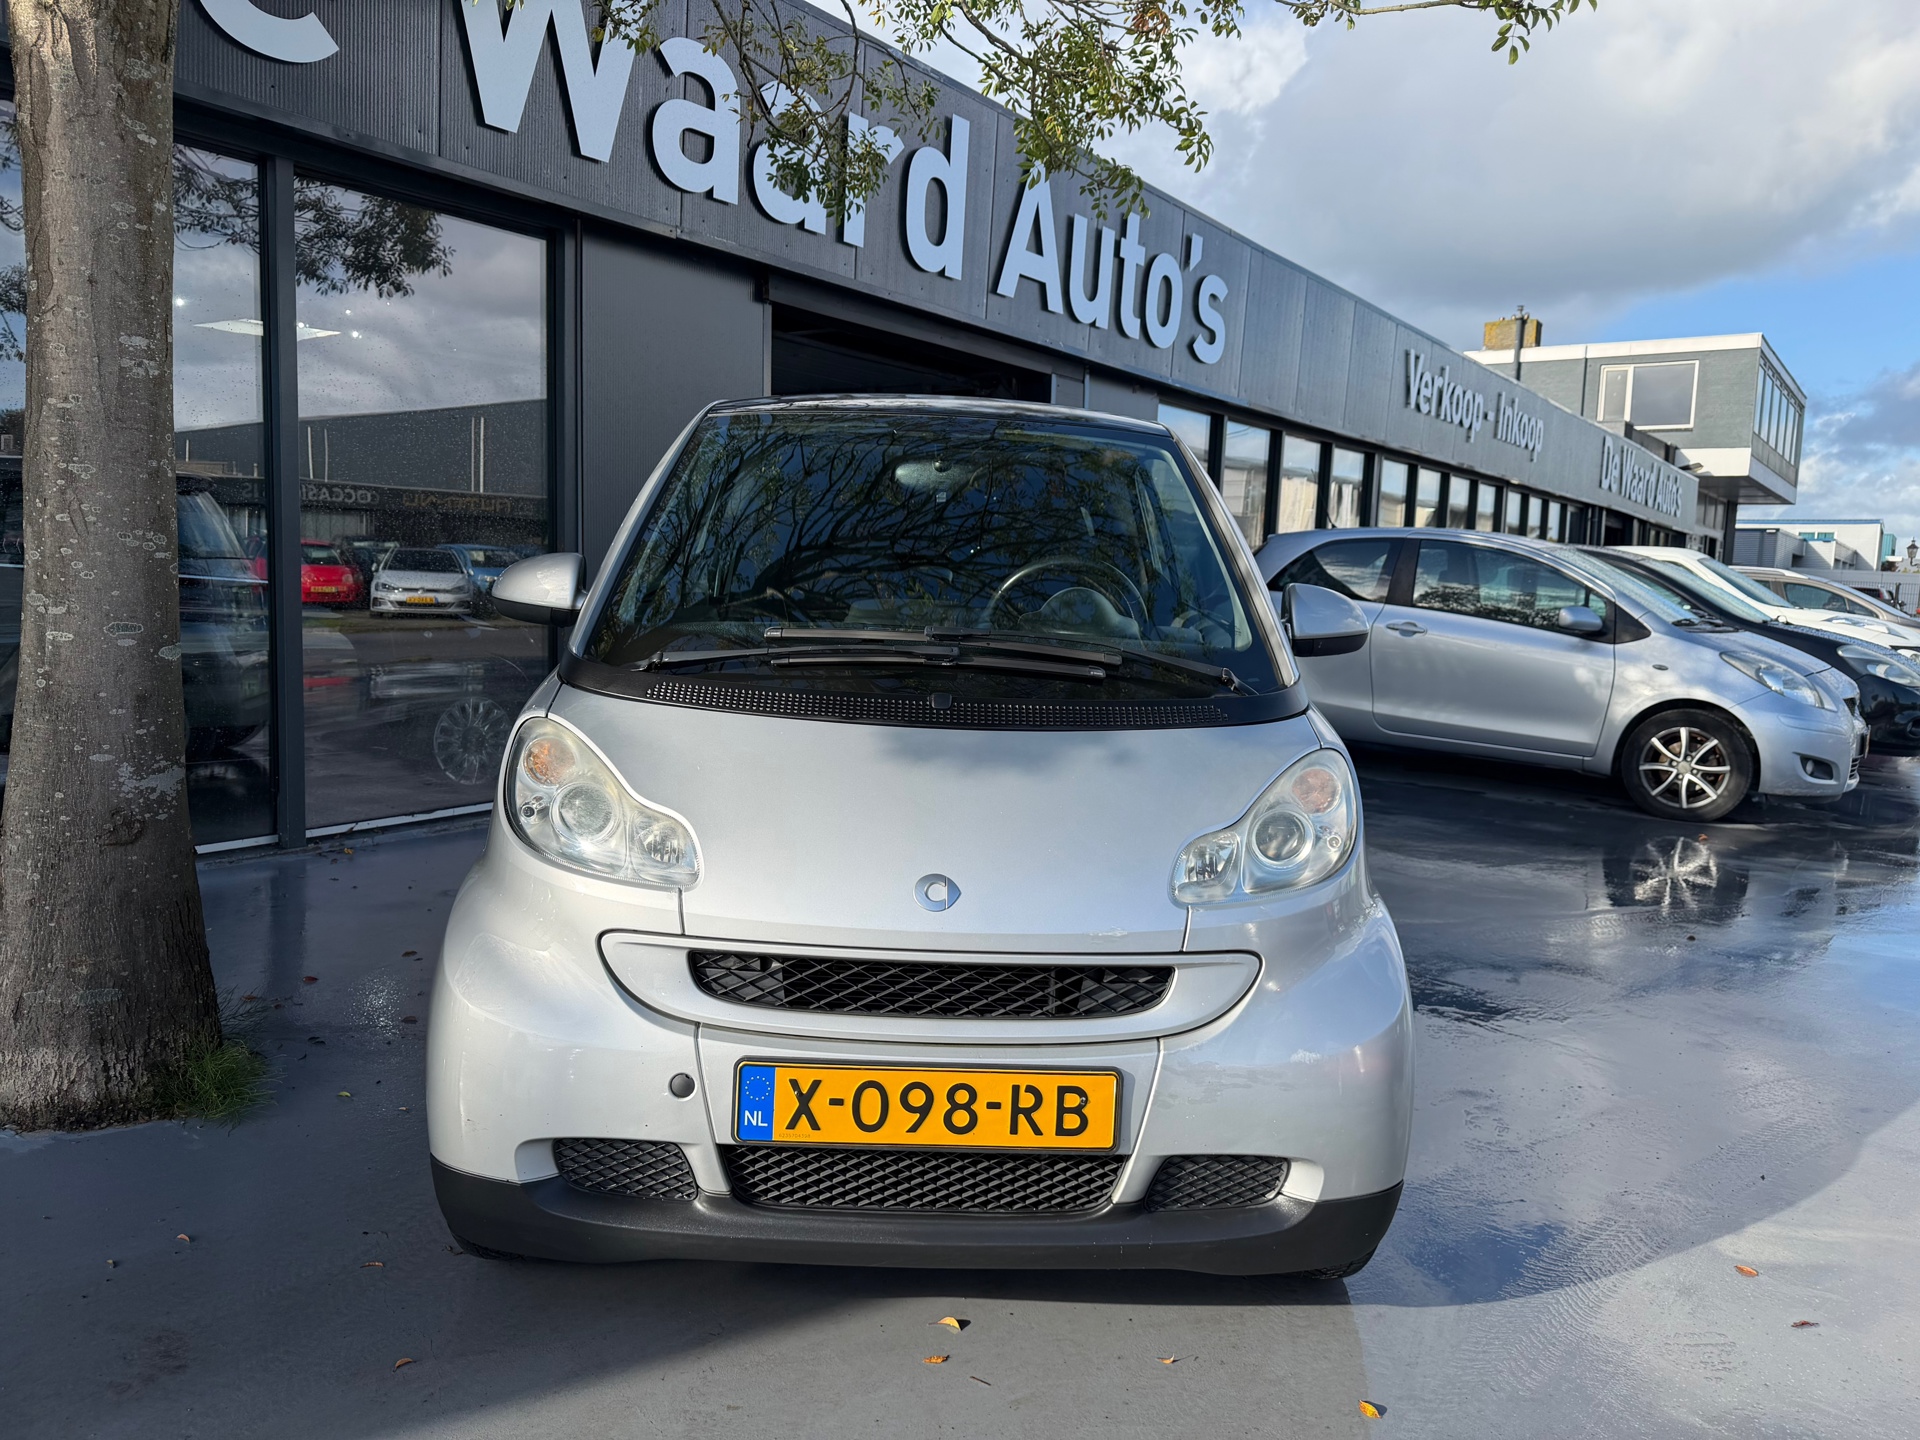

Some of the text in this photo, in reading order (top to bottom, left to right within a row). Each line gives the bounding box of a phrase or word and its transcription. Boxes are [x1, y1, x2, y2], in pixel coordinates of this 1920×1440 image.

[460, 0, 1228, 365] Waard Auto's
[1410, 349, 1484, 443] Verkoop
[1497, 391, 1544, 463] Inkoop
[1601, 435, 1620, 493] De
[1621, 445, 1658, 508] Waard
[744, 1078, 1089, 1136] NL X-098-RB
